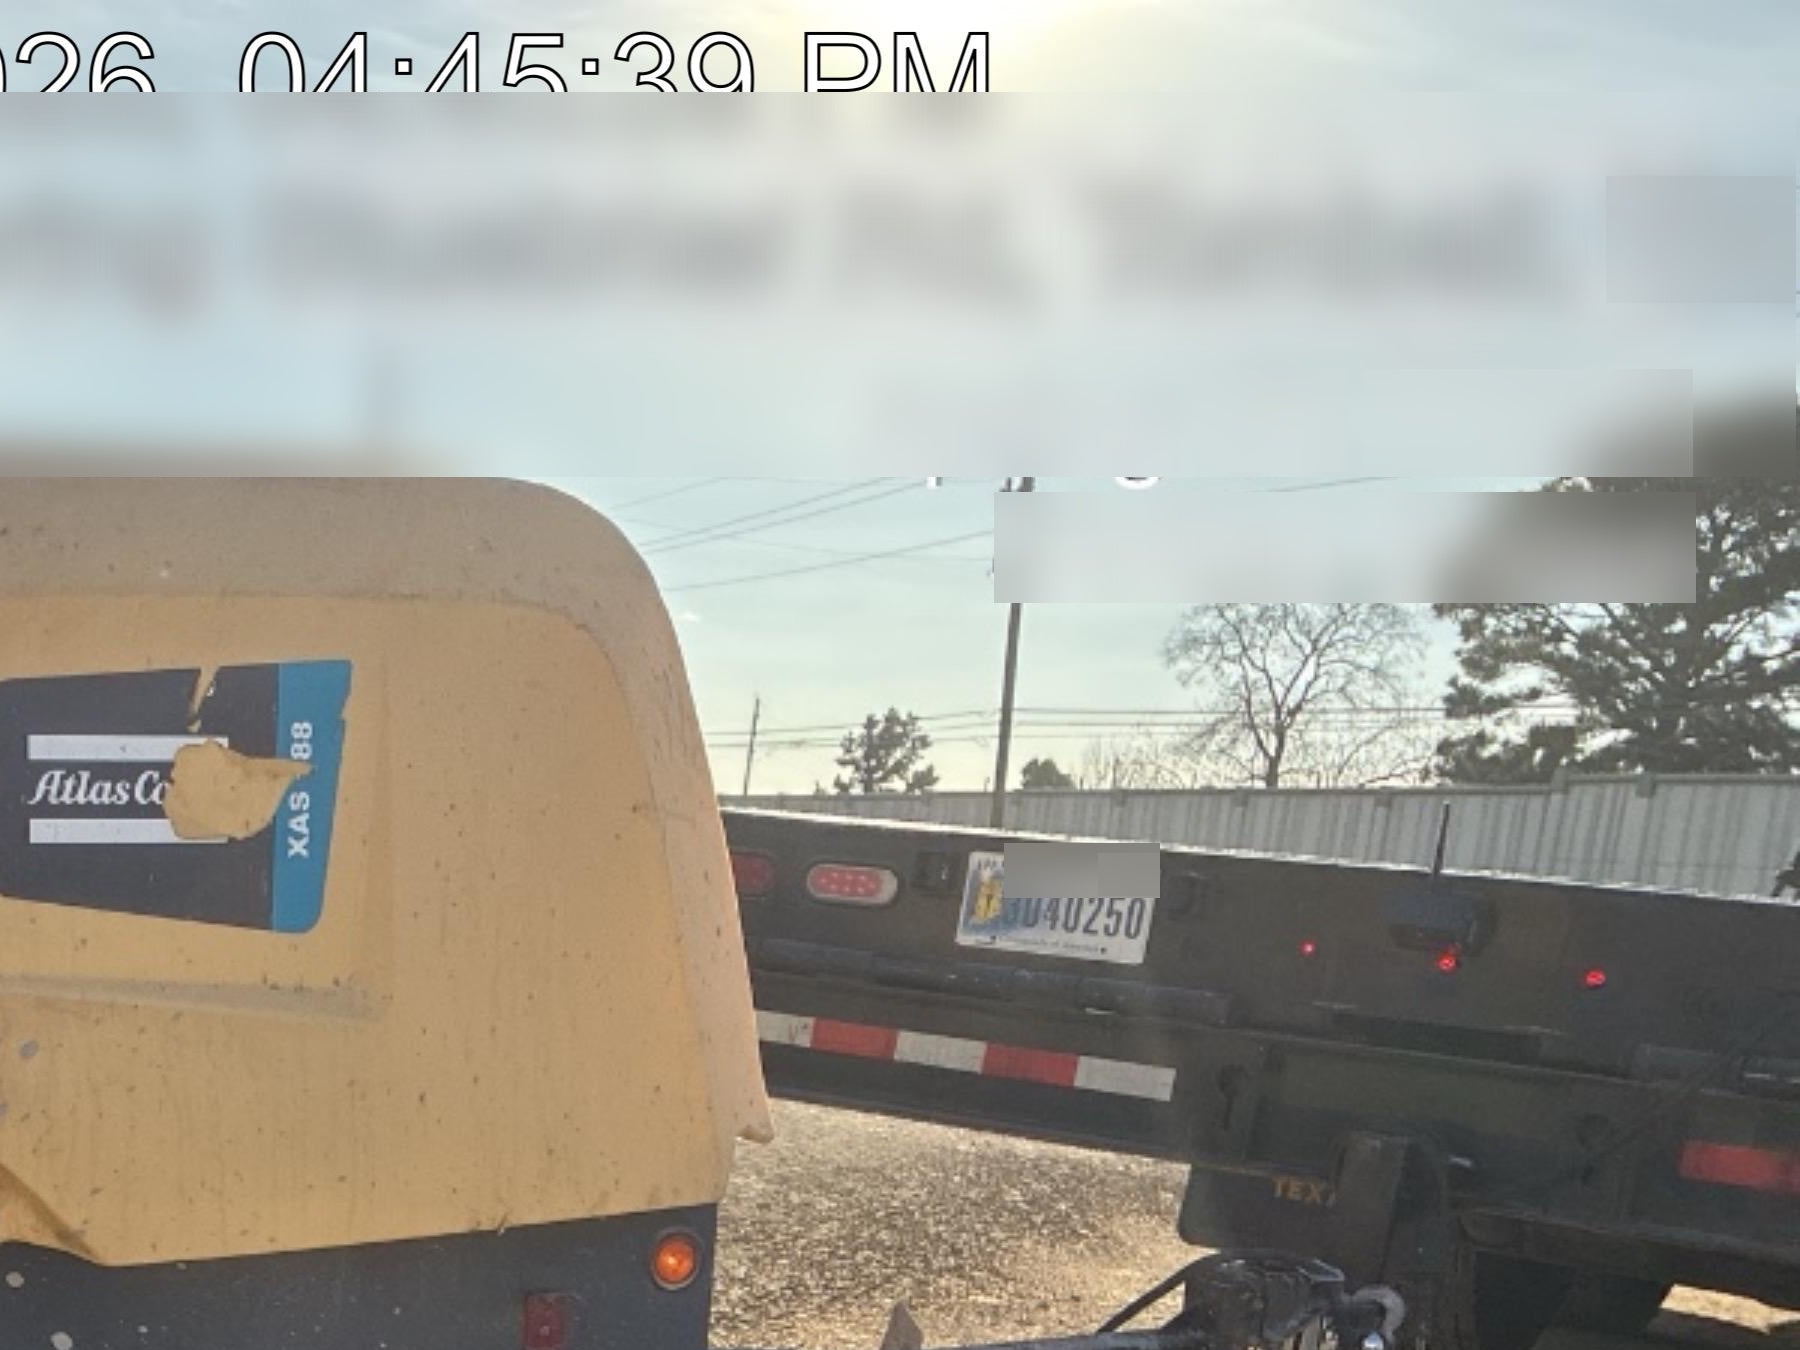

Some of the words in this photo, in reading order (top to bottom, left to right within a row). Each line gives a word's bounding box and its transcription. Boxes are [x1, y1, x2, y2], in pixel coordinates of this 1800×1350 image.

[290, 721, 313, 760] 88
[28, 769, 130, 805] Atlas
[287, 791, 310, 858] XAS
